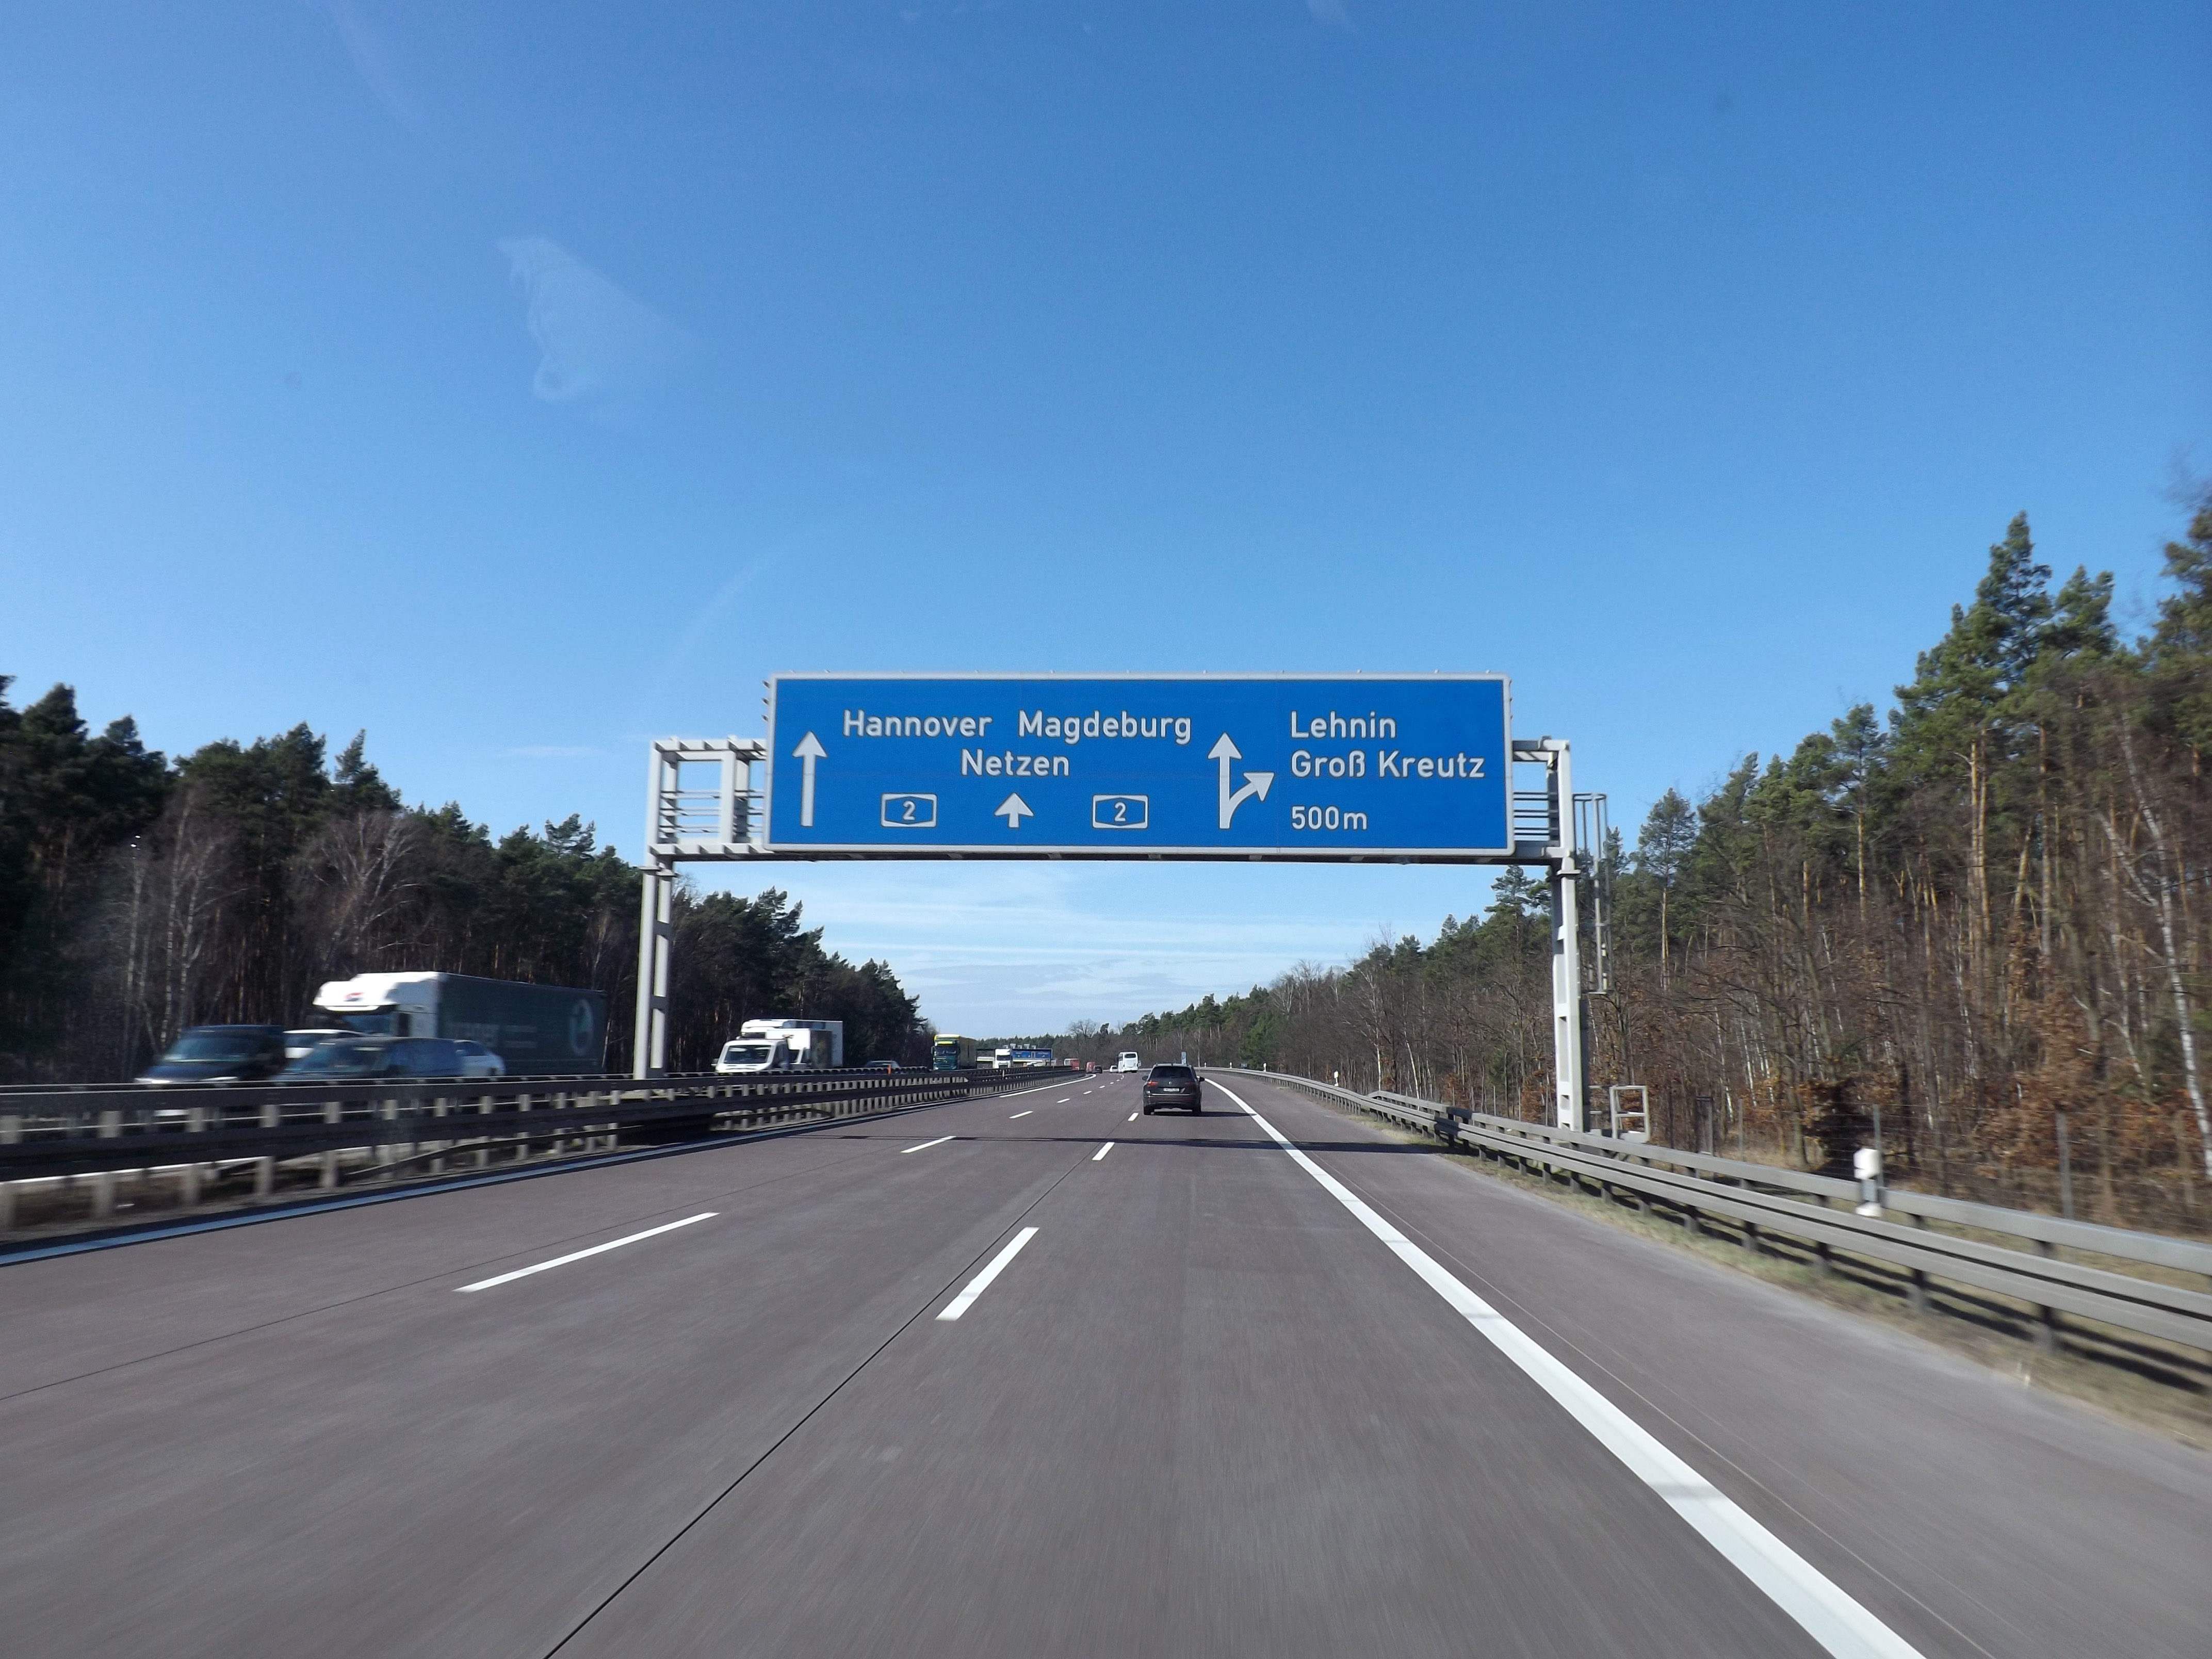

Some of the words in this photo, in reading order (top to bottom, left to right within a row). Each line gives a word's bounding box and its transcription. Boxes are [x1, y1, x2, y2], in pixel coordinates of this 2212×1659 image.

[844, 710, 992, 737] Hannover
[1019, 710, 1191, 744] Magdeburg
[1291, 711, 1395, 738] Lehnin
[962, 749, 1069, 776] Netzen
[1292, 750, 1365, 777] Groß
[1379, 751, 1484, 777] Kreutz
[903, 801, 915, 820] 2
[1114, 802, 1126, 822] 2
[1292, 806, 1367, 829] 500m
